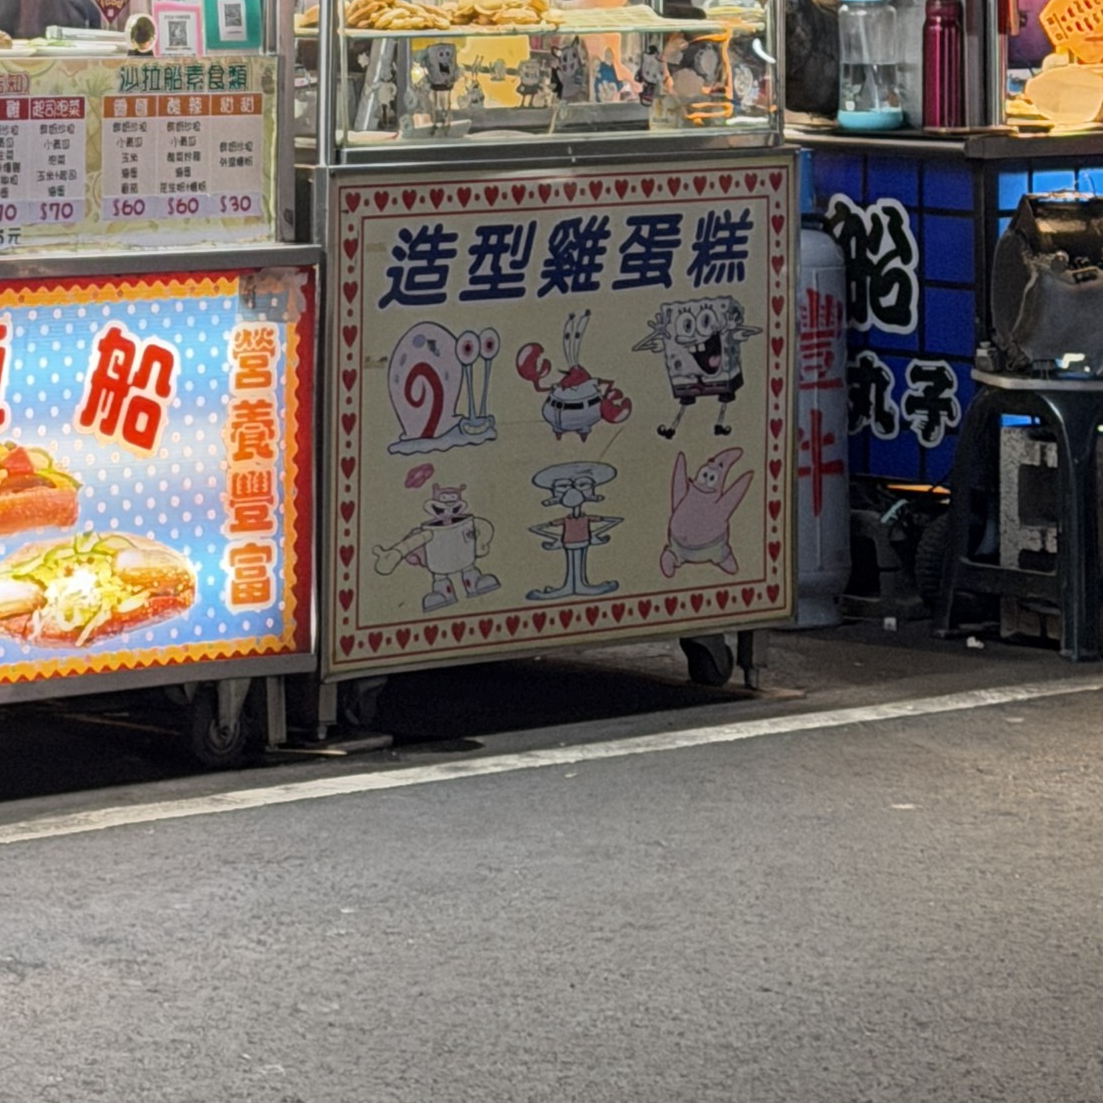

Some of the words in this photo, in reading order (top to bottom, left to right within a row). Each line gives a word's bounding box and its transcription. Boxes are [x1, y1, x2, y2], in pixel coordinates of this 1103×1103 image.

[119, 64, 249, 94] 沙拉船素食類
[378, 205, 754, 310] 造型雞蛋糕
[229, 326, 278, 610] 營養豐富
